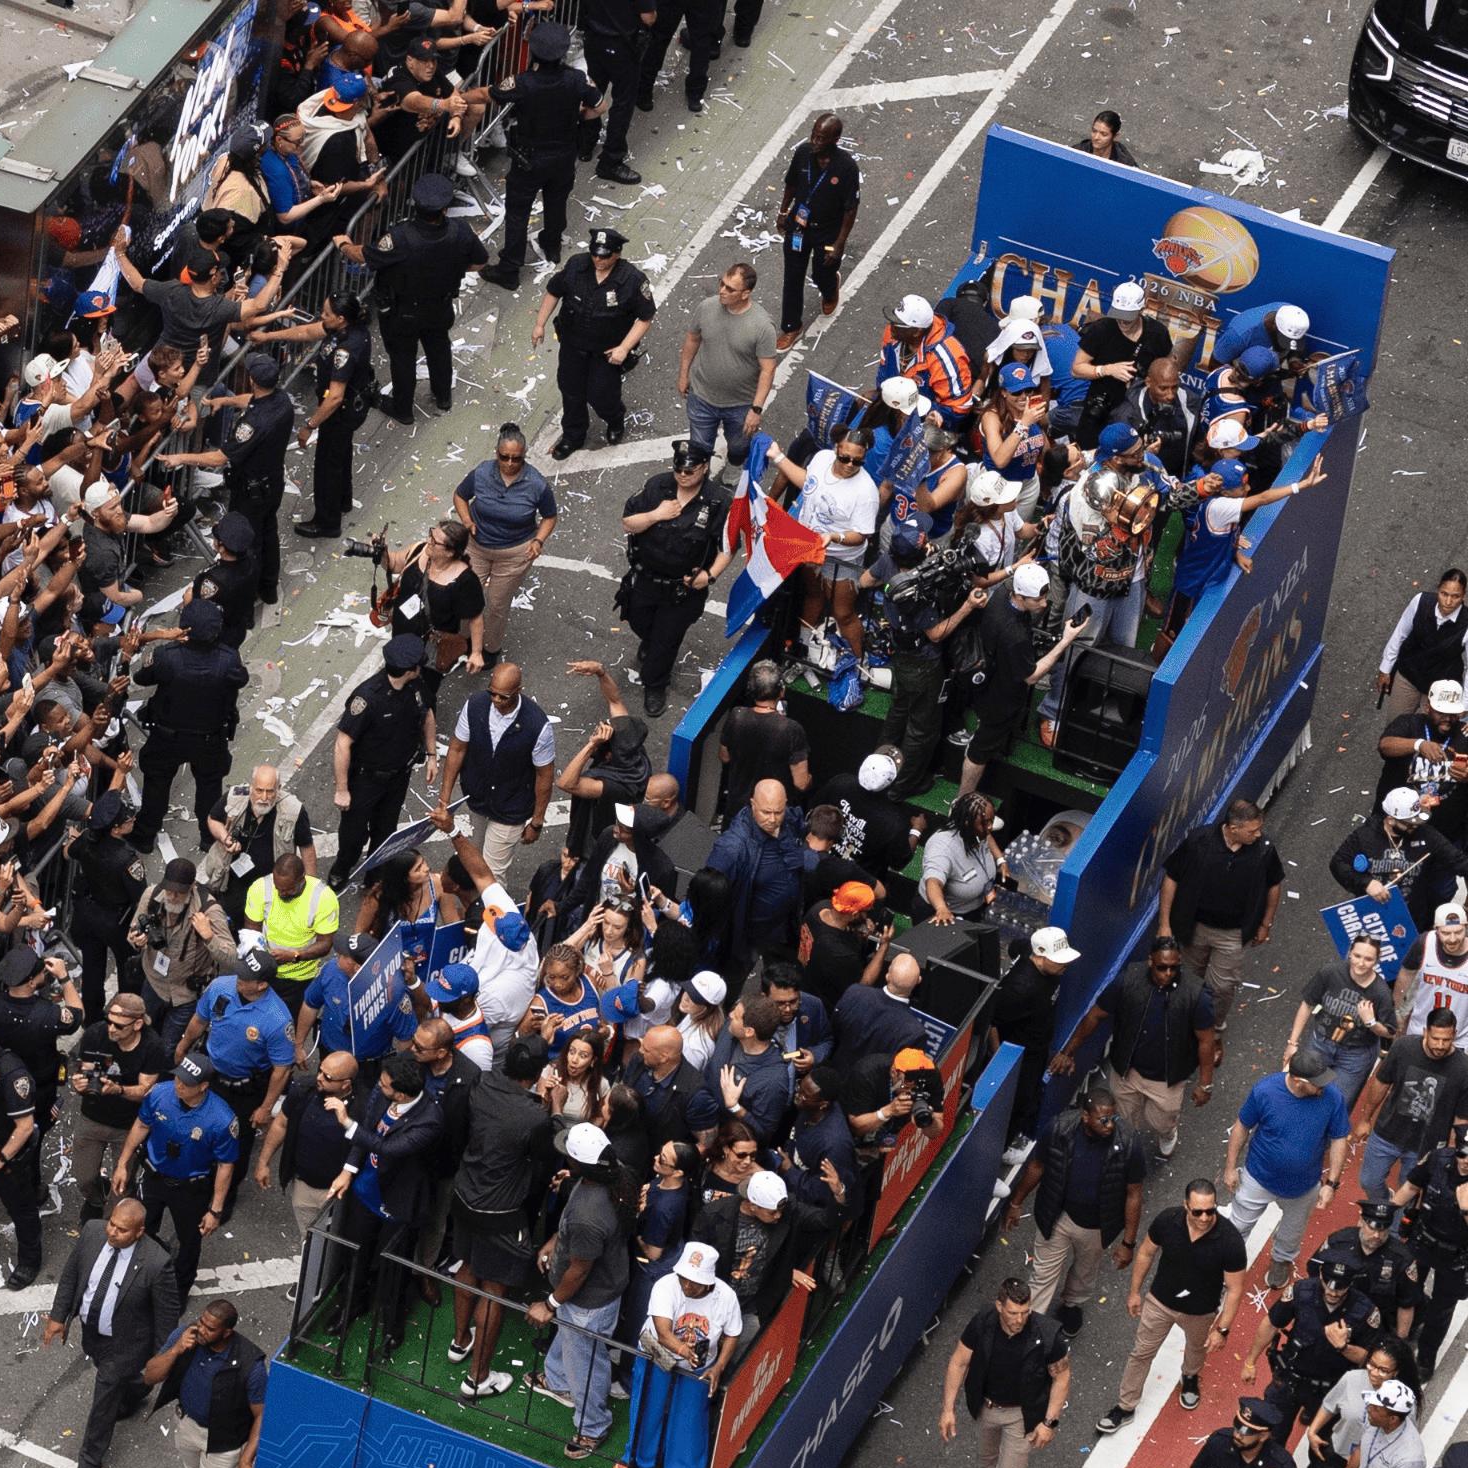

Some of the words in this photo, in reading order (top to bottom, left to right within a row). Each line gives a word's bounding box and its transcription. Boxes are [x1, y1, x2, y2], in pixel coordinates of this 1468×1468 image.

[153, 198, 198, 251] Spectrum
[1178, 290, 1217, 313] NBA
[1362, 911, 1391, 949] CITY
[1380, 943, 1399, 964] OF
[353, 974, 383, 1021] THANK
[384, 951, 402, 983] YOU
[1423, 973, 1445, 986] NEW
[363, 990, 389, 1031] FANS!
[1434, 991, 1452, 1010] 11
